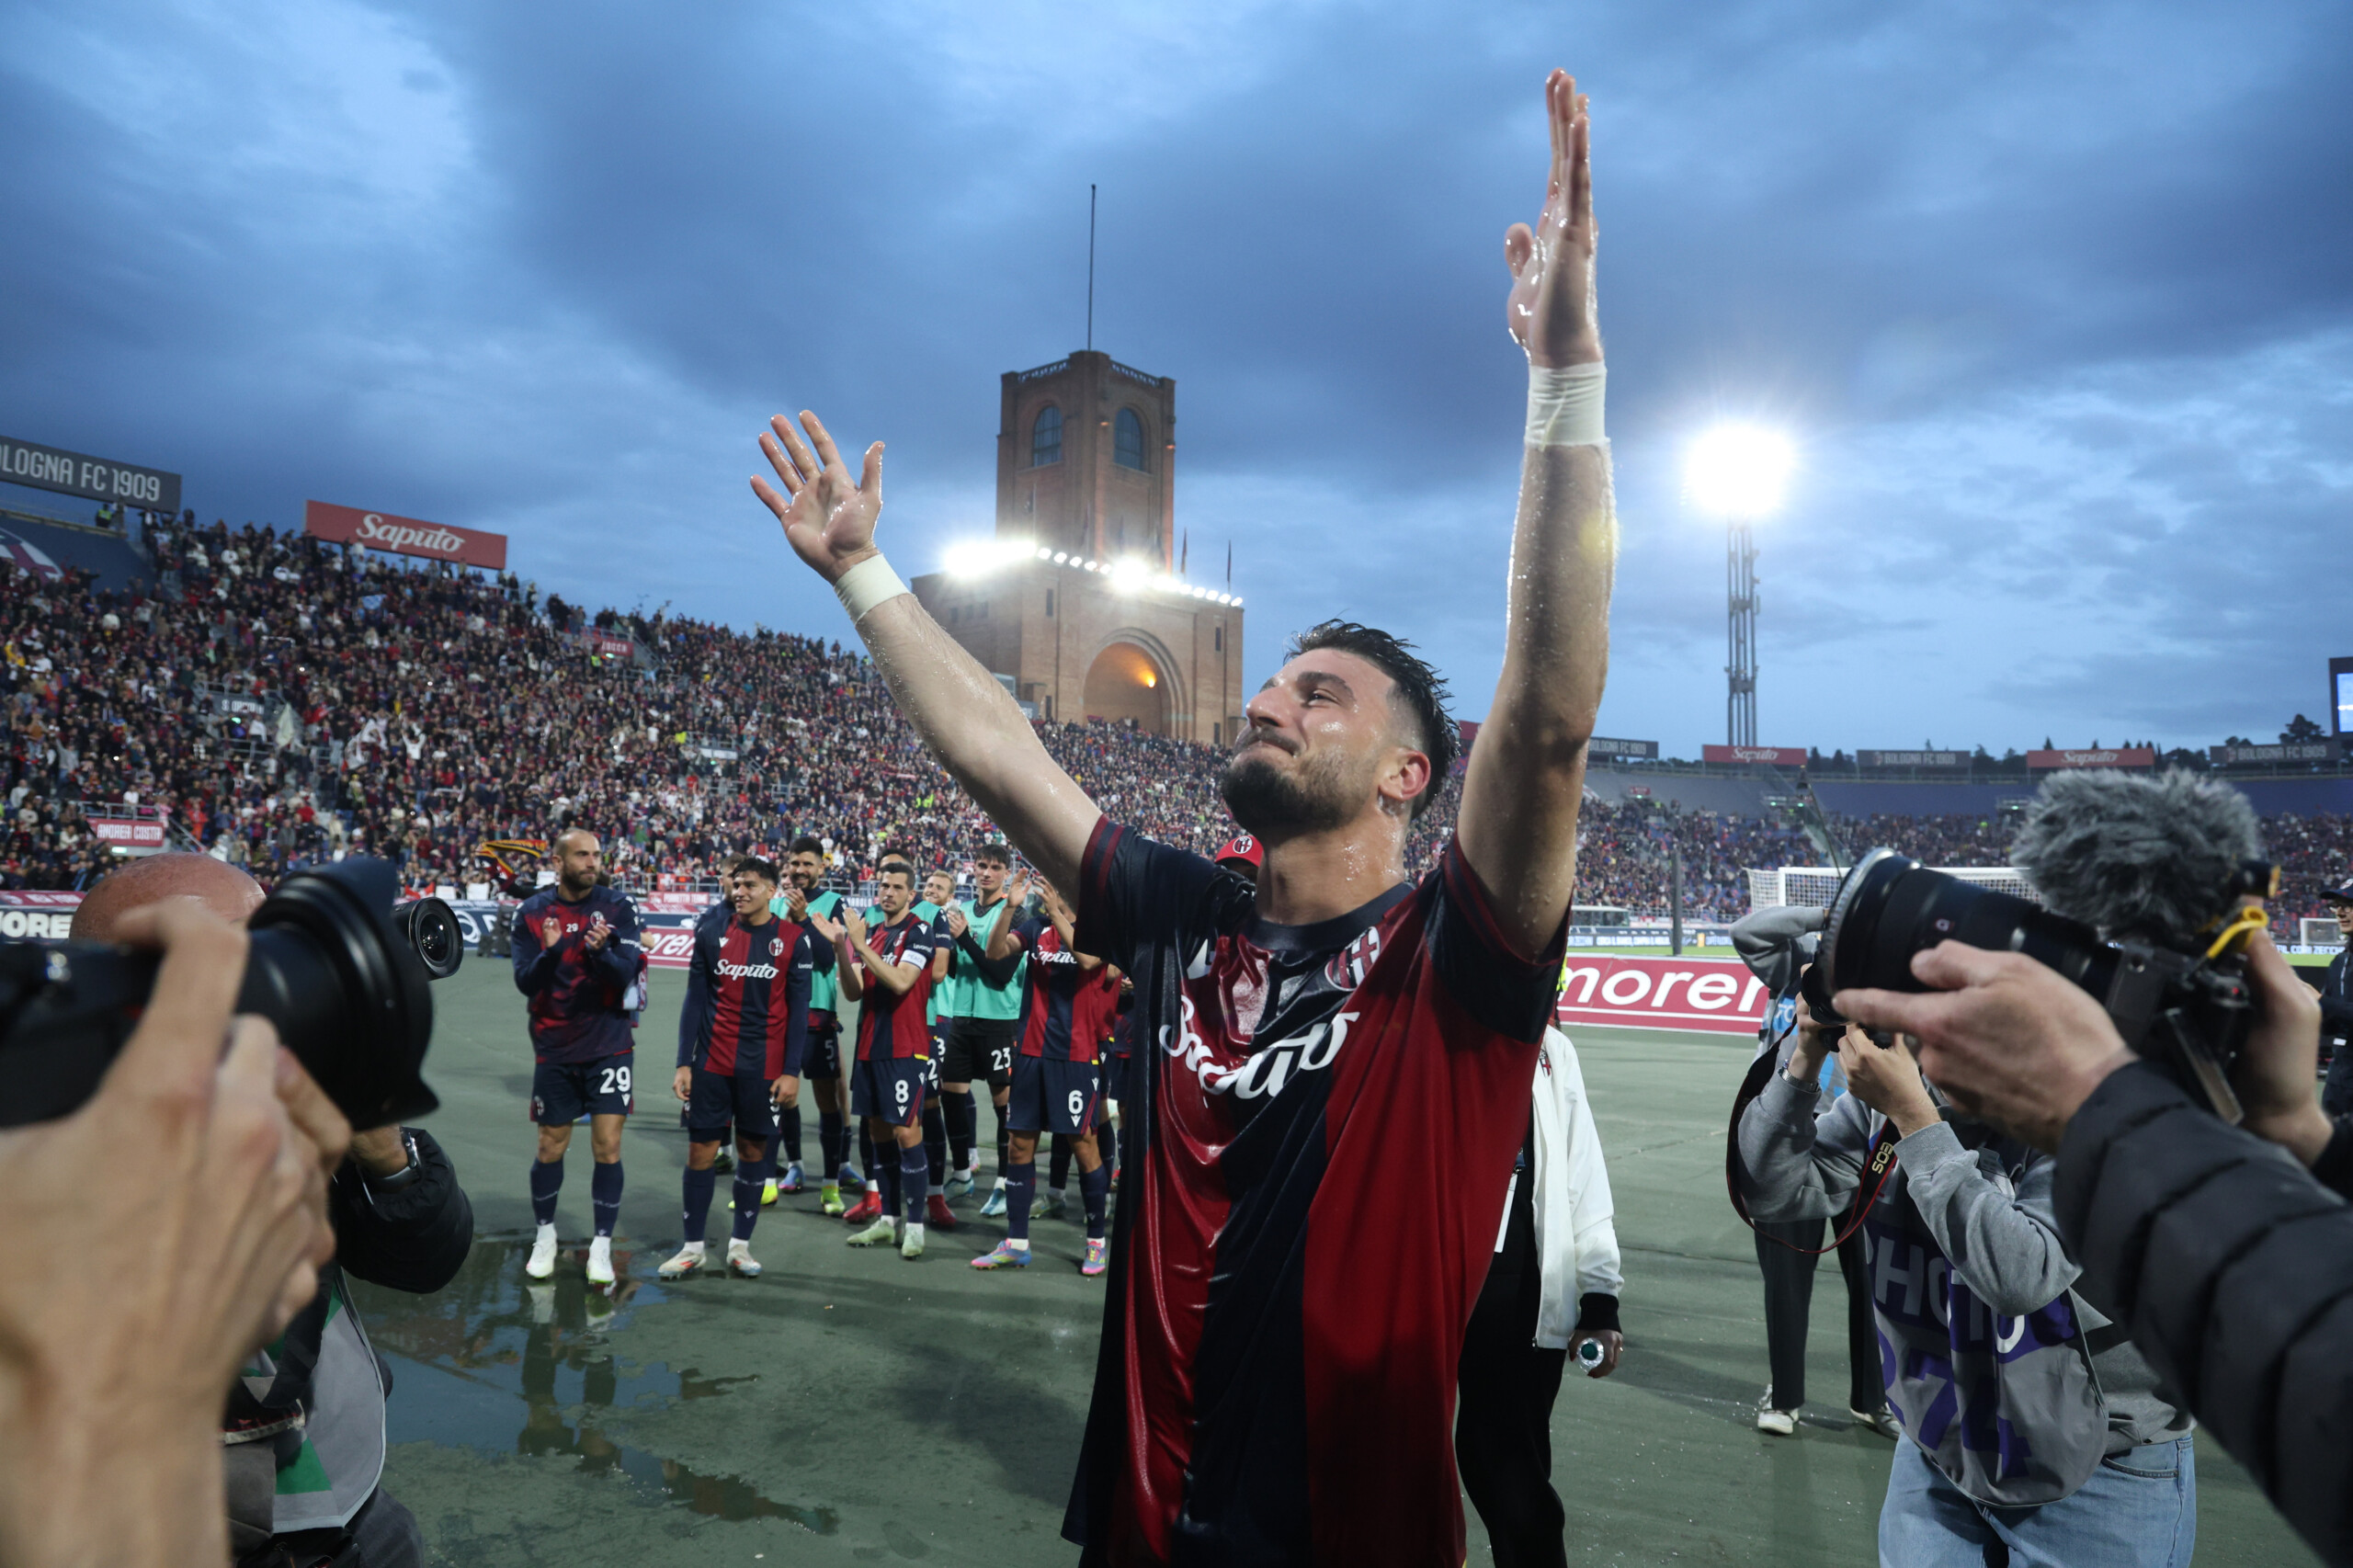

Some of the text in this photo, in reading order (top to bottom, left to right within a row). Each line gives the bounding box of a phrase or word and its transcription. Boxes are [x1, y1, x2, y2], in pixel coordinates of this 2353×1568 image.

[0, 444, 161, 503] LOGNA FC 1909
[355, 513, 466, 552] Saputo
[1589, 738, 1646, 756] BOLOGNA FC 1909
[1731, 746, 1779, 764] Saputo
[2061, 749, 2120, 767] Saputo
[2237, 744, 2326, 761] BOLOGNA FC 1909
[1883, 752, 1956, 766] BOLOGNA FC 1909
[97, 824, 163, 841] ANDREA COSTA
[0, 911, 73, 939] ORE
[565, 923, 579, 933] 29
[713, 958, 780, 981] Saputo
[991, 1047, 1011, 1072] 23
[599, 1065, 631, 1095] 29
[894, 1080, 909, 1104] 8
[1068, 1089, 1083, 1115] 6
[1871, 1142, 1893, 1175] EOS
